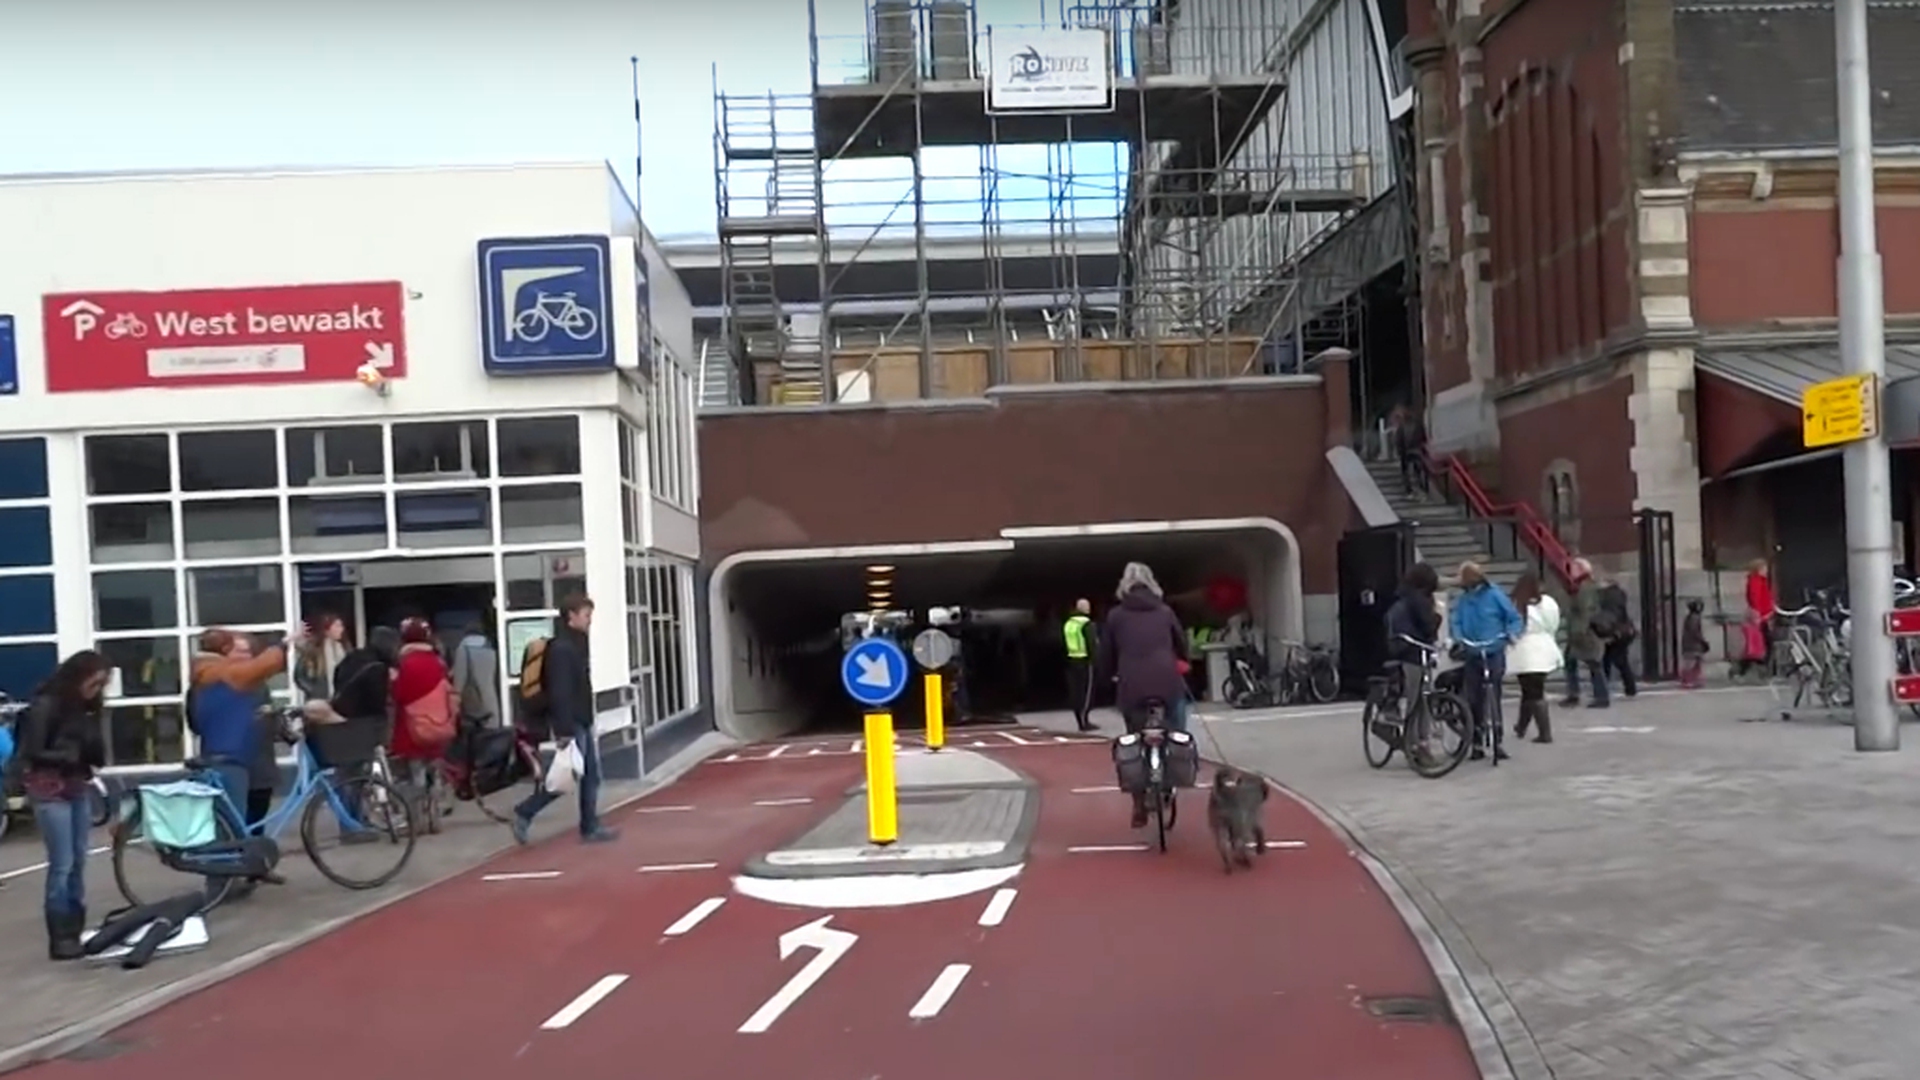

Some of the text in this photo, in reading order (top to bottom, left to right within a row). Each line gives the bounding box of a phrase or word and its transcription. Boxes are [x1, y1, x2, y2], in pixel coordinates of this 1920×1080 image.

[74, 302, 384, 341] P West bewaakt
